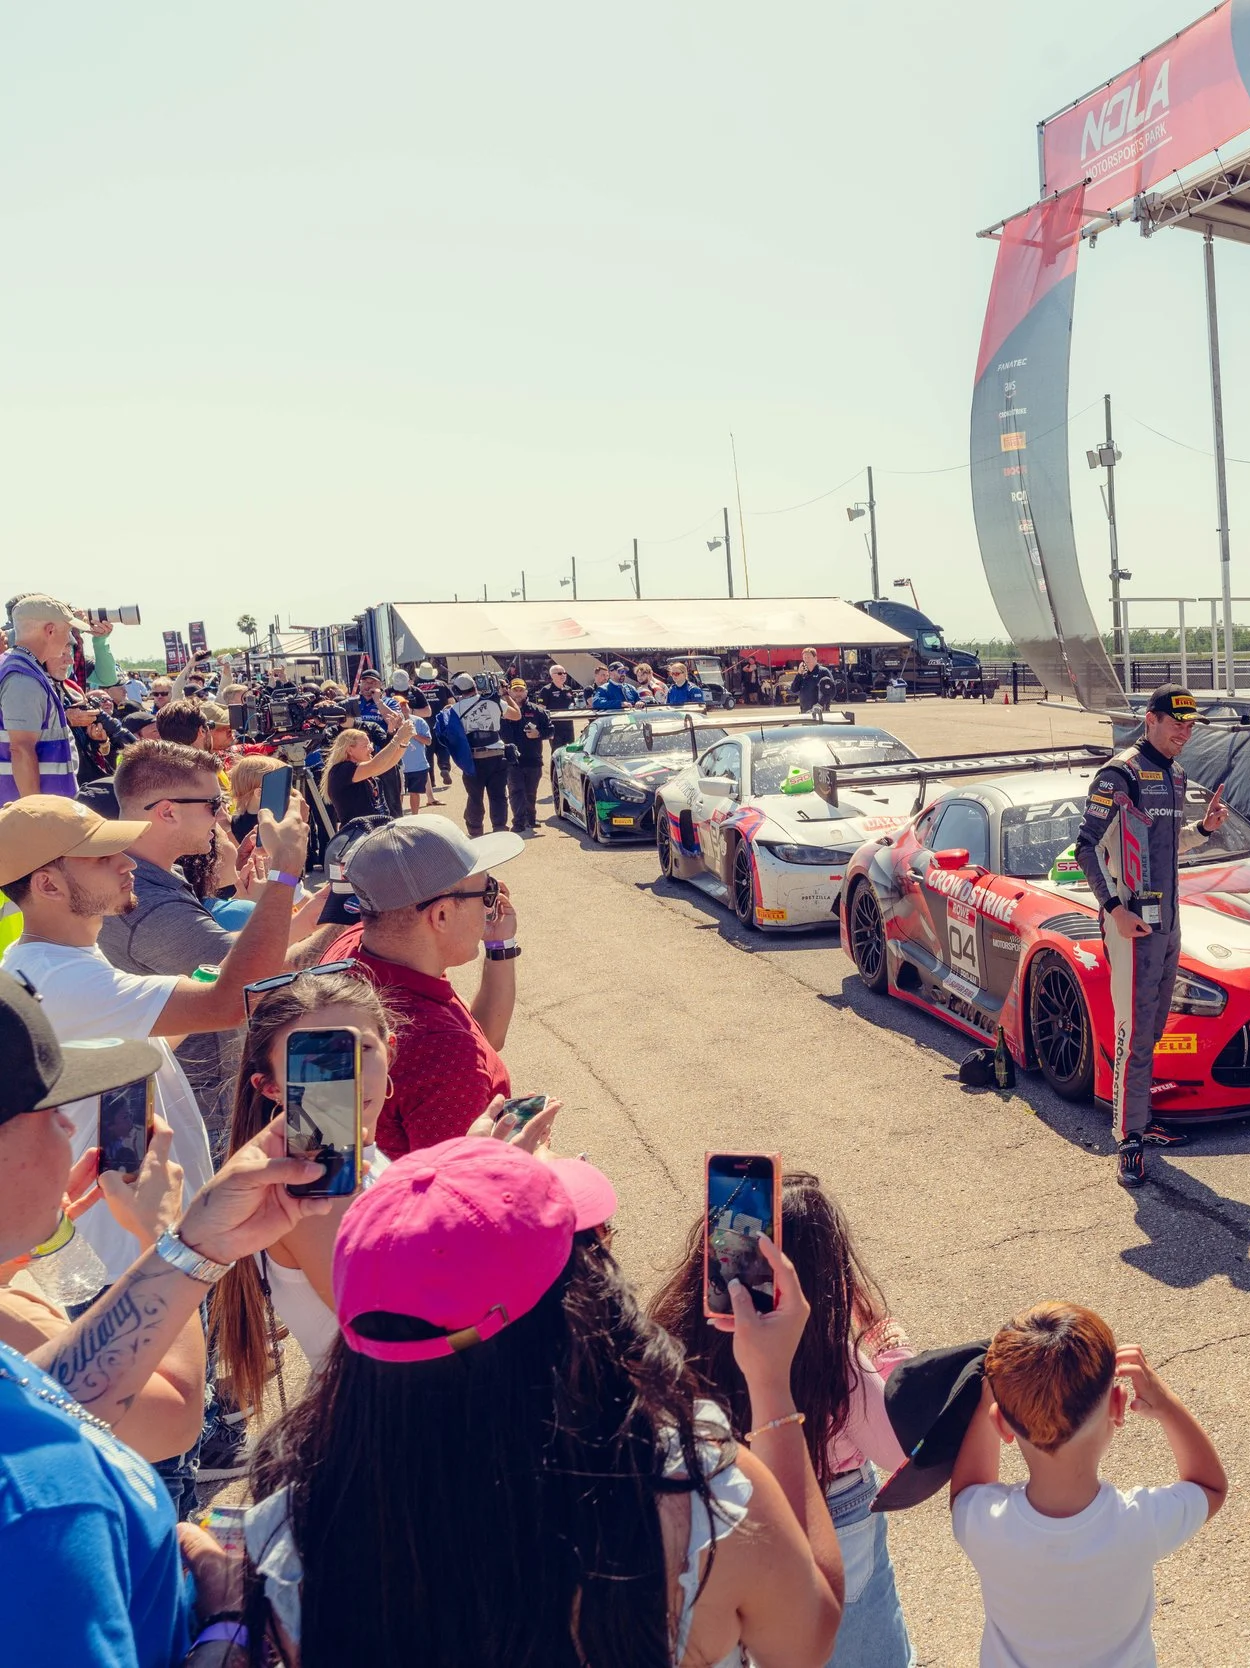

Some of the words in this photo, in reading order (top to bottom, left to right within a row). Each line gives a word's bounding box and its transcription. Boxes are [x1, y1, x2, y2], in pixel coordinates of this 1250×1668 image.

[1081, 59, 1170, 160] NOLA
[1086, 139, 1144, 179] MOTORSPORTS
[1145, 121, 1167, 151] PARK
[997, 358, 1027, 371] FANATEC
[853, 751, 1086, 776] CROWDSTRIKE
[1100, 781, 1114, 789] aws
[928, 870, 1018, 923] CROWDSTRIKE
[952, 902, 970, 920] ROWE
[949, 925, 976, 968] 04
